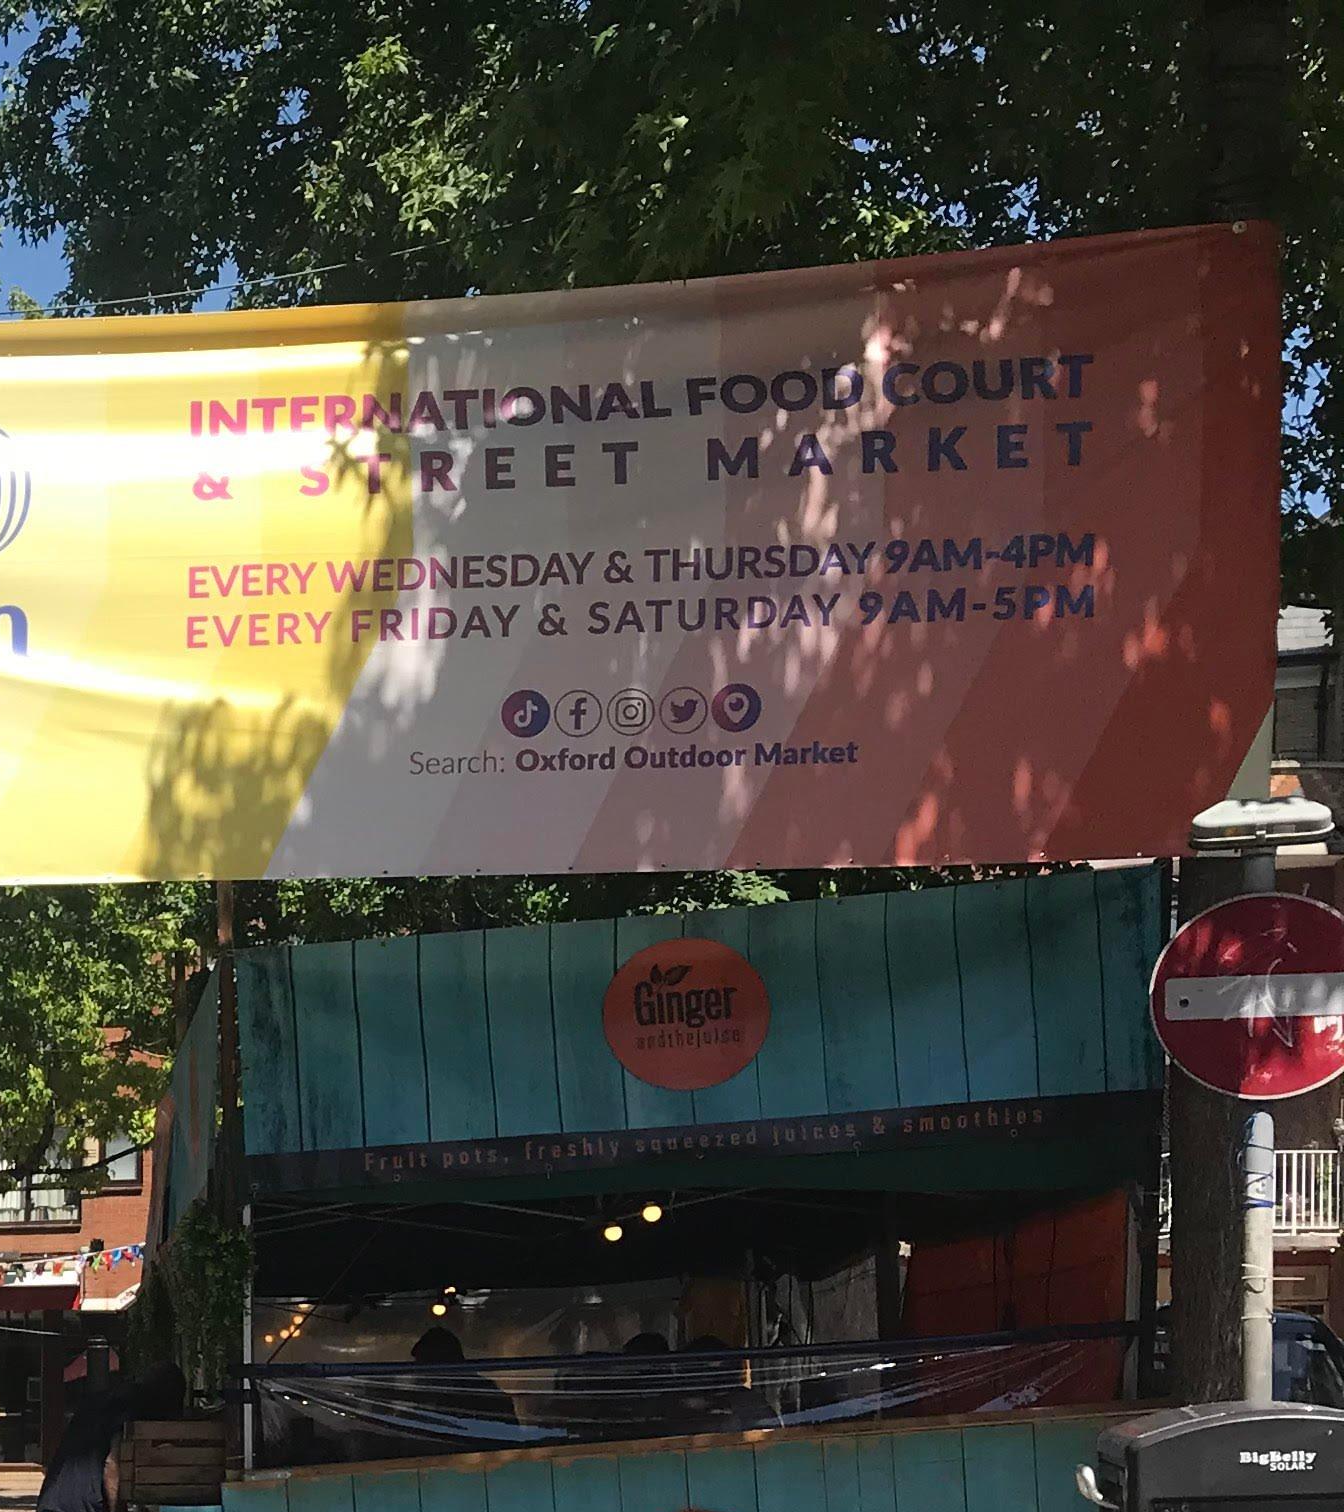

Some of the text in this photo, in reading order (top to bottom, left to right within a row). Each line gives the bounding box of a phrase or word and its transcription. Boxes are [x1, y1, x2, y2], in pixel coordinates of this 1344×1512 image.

[190, 354, 1095, 437] INTERNATIONAL FOOD COURT
[192, 421, 1094, 500] & STREET MARKET
[188, 532, 1096, 599] EVERY WEDNESDAY & THURSDAY 9AM-4PM
[186, 584, 1095, 649] EVERY FRIDAY & SATURDAY 9AM-5PM
[409, 740, 859, 776] Search: Oxford Outdoor Market
[633, 981, 738, 1029] Ginger
[363, 1152, 428, 1171] Fruit
[525, 1137, 620, 1160] freshly
[634, 1127, 757, 1154] squeezed
[772, 1122, 858, 1147] juices
[871, 1114, 886, 1135] &
[902, 1106, 1044, 1134] smoothies
[1239, 1451, 1317, 1466] BigBelly
[1269, 1462, 1306, 1472] SOLAR
